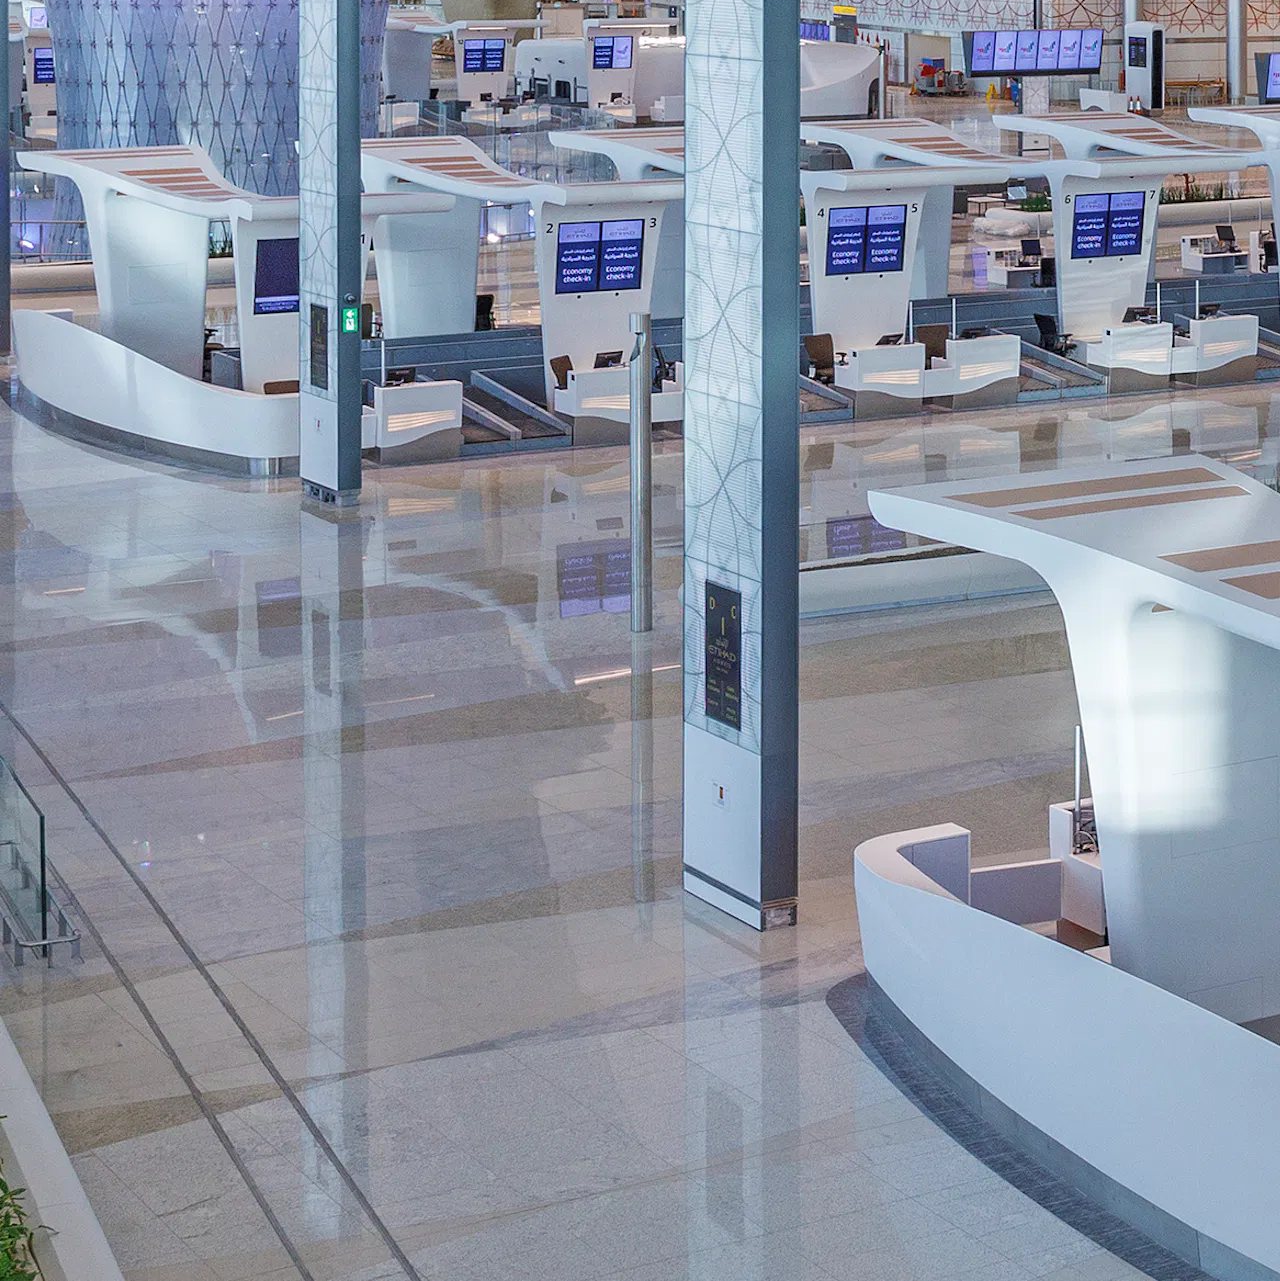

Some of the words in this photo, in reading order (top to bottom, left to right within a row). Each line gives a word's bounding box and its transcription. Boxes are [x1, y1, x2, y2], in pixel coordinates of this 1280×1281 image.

[1064, 194, 1071, 204] 6
[1149, 190, 1156, 200] 7
[817, 208, 825, 217] 4
[911, 203, 918, 213] 5
[649, 218, 657, 228] 3
[546, 223, 554, 234] 2
[871, 255, 897, 263] check-in
[562, 267, 593, 275] Economy
[605, 265, 636, 273] Economy
[563, 275, 591, 283] check-in
[606, 273, 634, 281] check-in
[709, 597, 715, 610] D
[731, 605, 736, 620] C
